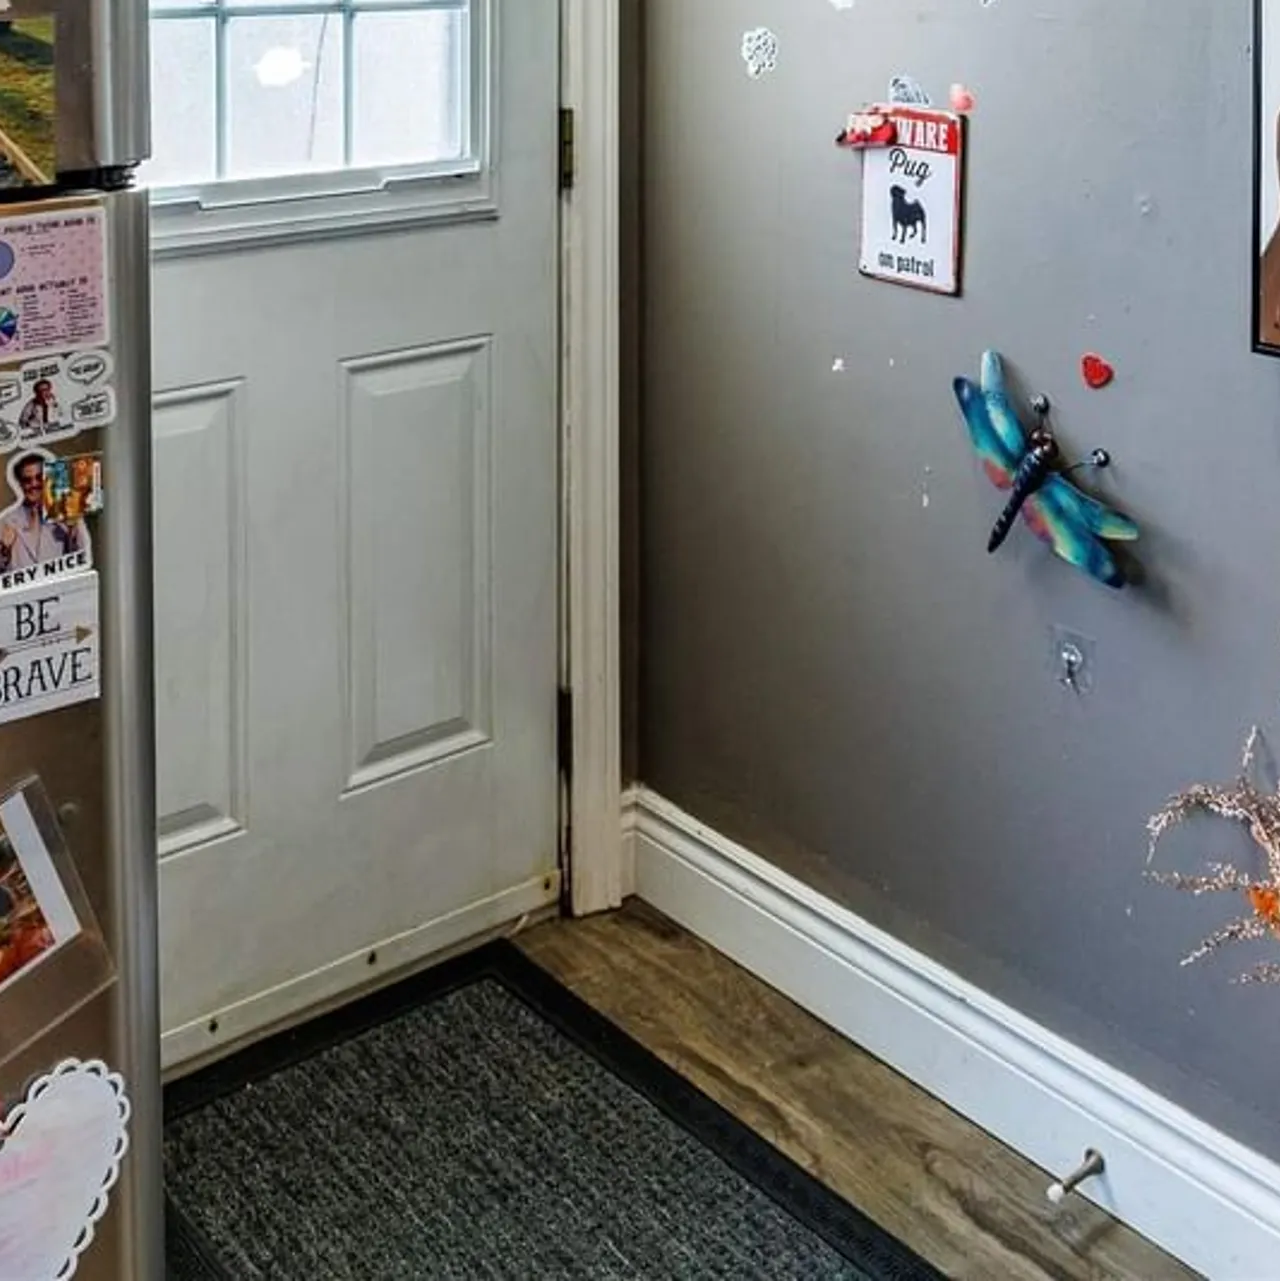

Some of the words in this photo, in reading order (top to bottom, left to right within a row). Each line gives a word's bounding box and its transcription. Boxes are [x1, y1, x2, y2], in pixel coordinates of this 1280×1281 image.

[896, 119, 949, 150] WARE
[889, 148, 931, 187] Pug
[897, 255, 934, 277] patrol
[44, 551, 87, 577] NICE
[14, 596, 61, 642] BE
